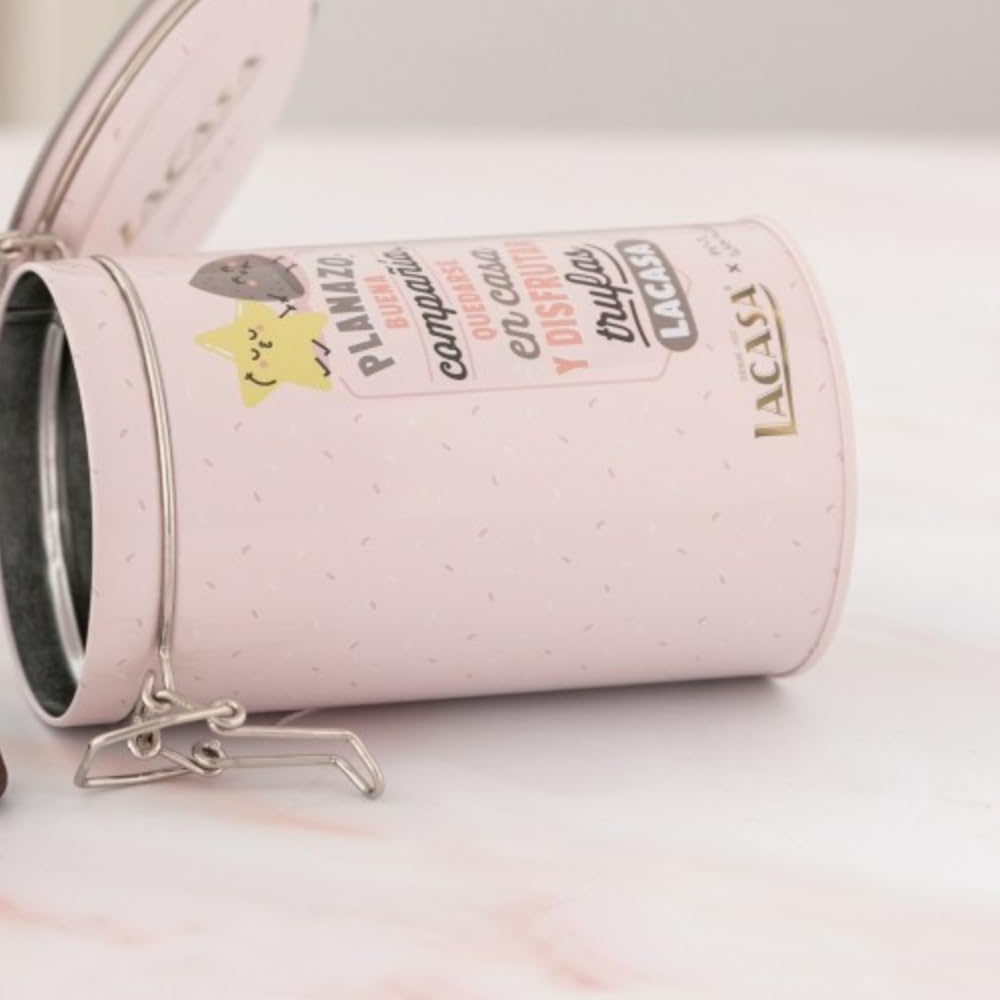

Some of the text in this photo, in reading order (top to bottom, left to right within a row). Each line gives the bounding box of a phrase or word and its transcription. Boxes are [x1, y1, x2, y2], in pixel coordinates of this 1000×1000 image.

[363, 273, 409, 329] BUENA
[471, 246, 541, 360] en casa
[563, 245, 636, 344] trufas
[622, 243, 692, 340] LACASA
[551, 355, 590, 376] Y
